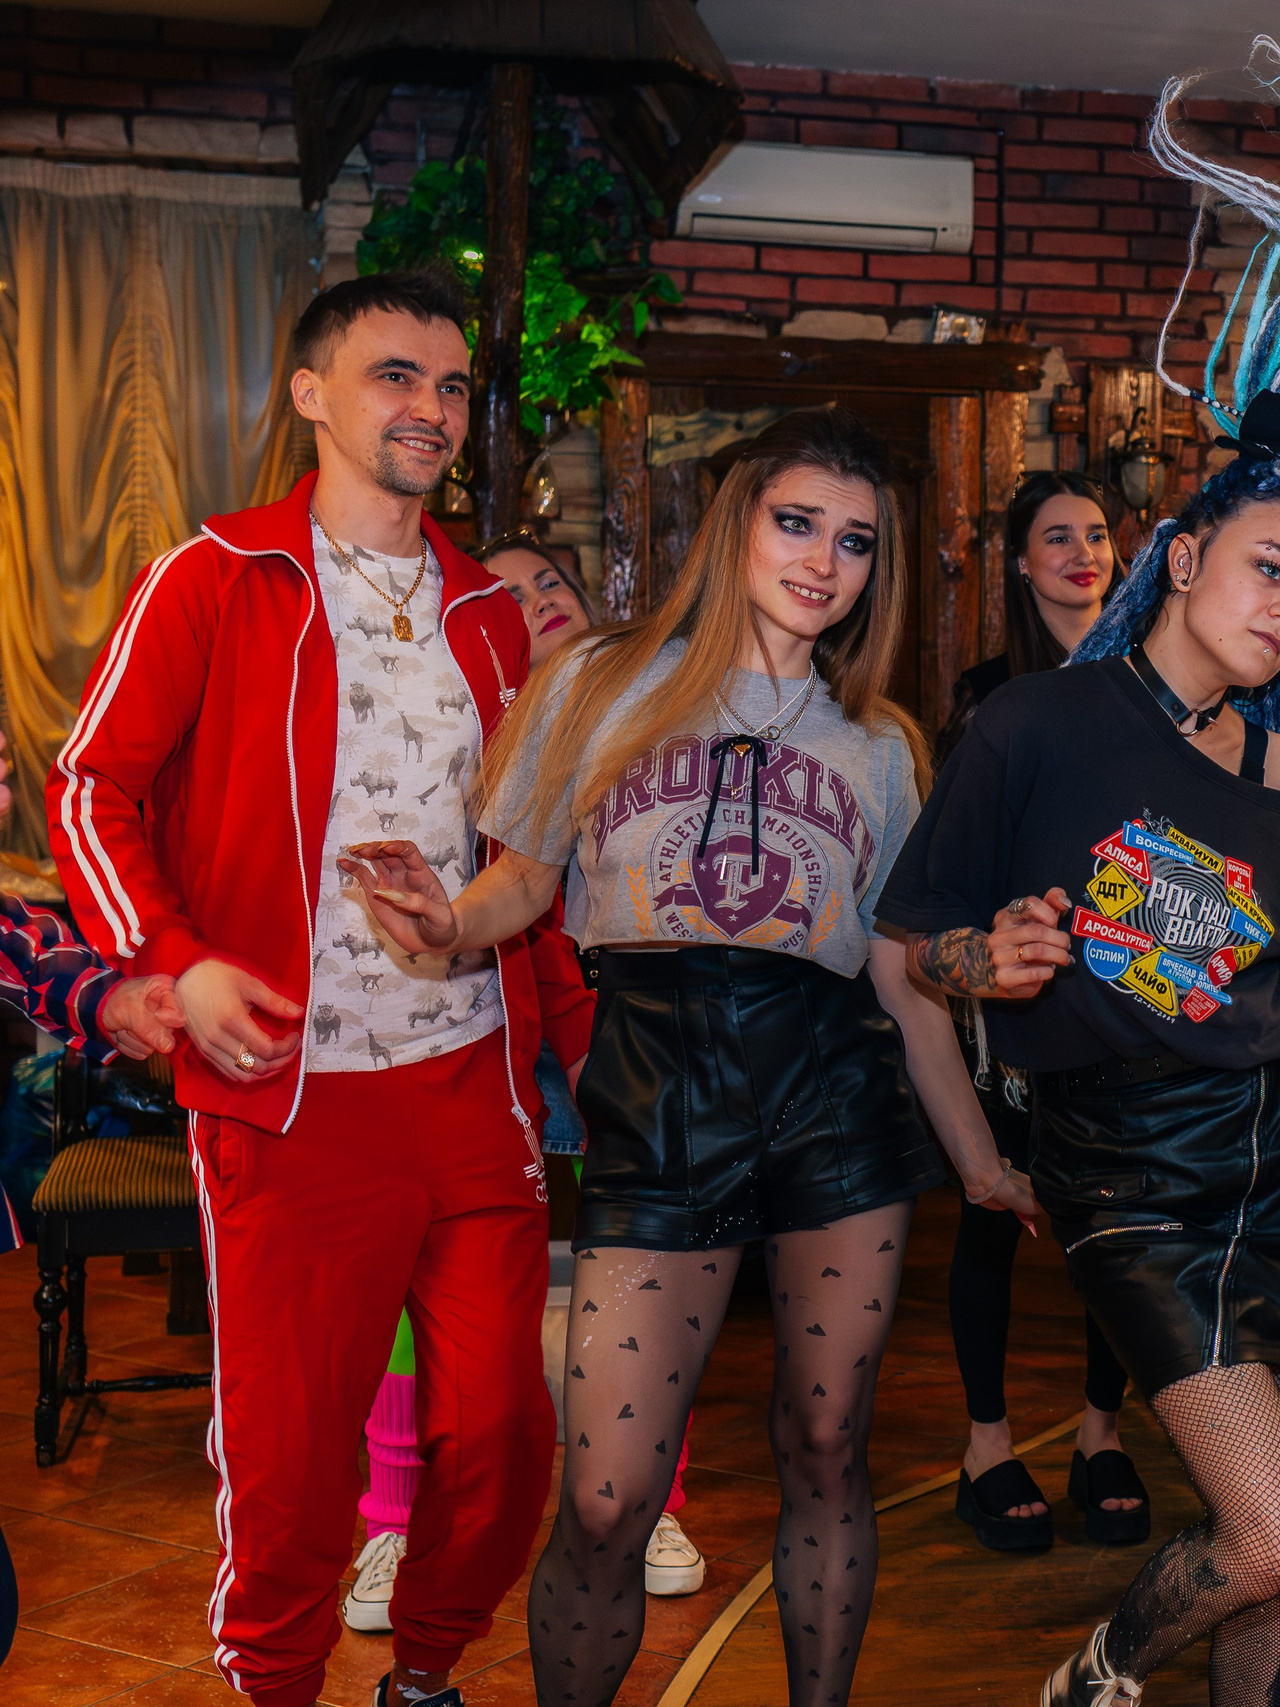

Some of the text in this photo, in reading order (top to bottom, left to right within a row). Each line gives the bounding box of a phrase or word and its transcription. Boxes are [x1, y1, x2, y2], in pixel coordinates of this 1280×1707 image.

[1103, 842, 1144, 874] АЛИСА
[1169, 831, 1220, 870] АКВАРИУМ
[1096, 880, 1128, 901] ДДТ
[1147, 876, 1232, 930] РОК НАД
[1229, 889, 1249, 910] АГАТА
[1083, 919, 1151, 949] APOCALYPTICA
[1163, 915, 1231, 949] ВОЛГОЙ
[1089, 947, 1125, 964] СПЛИН
[1210, 955, 1233, 981] АРИЯ
[1133, 965, 1168, 995] ЧАЙФ
